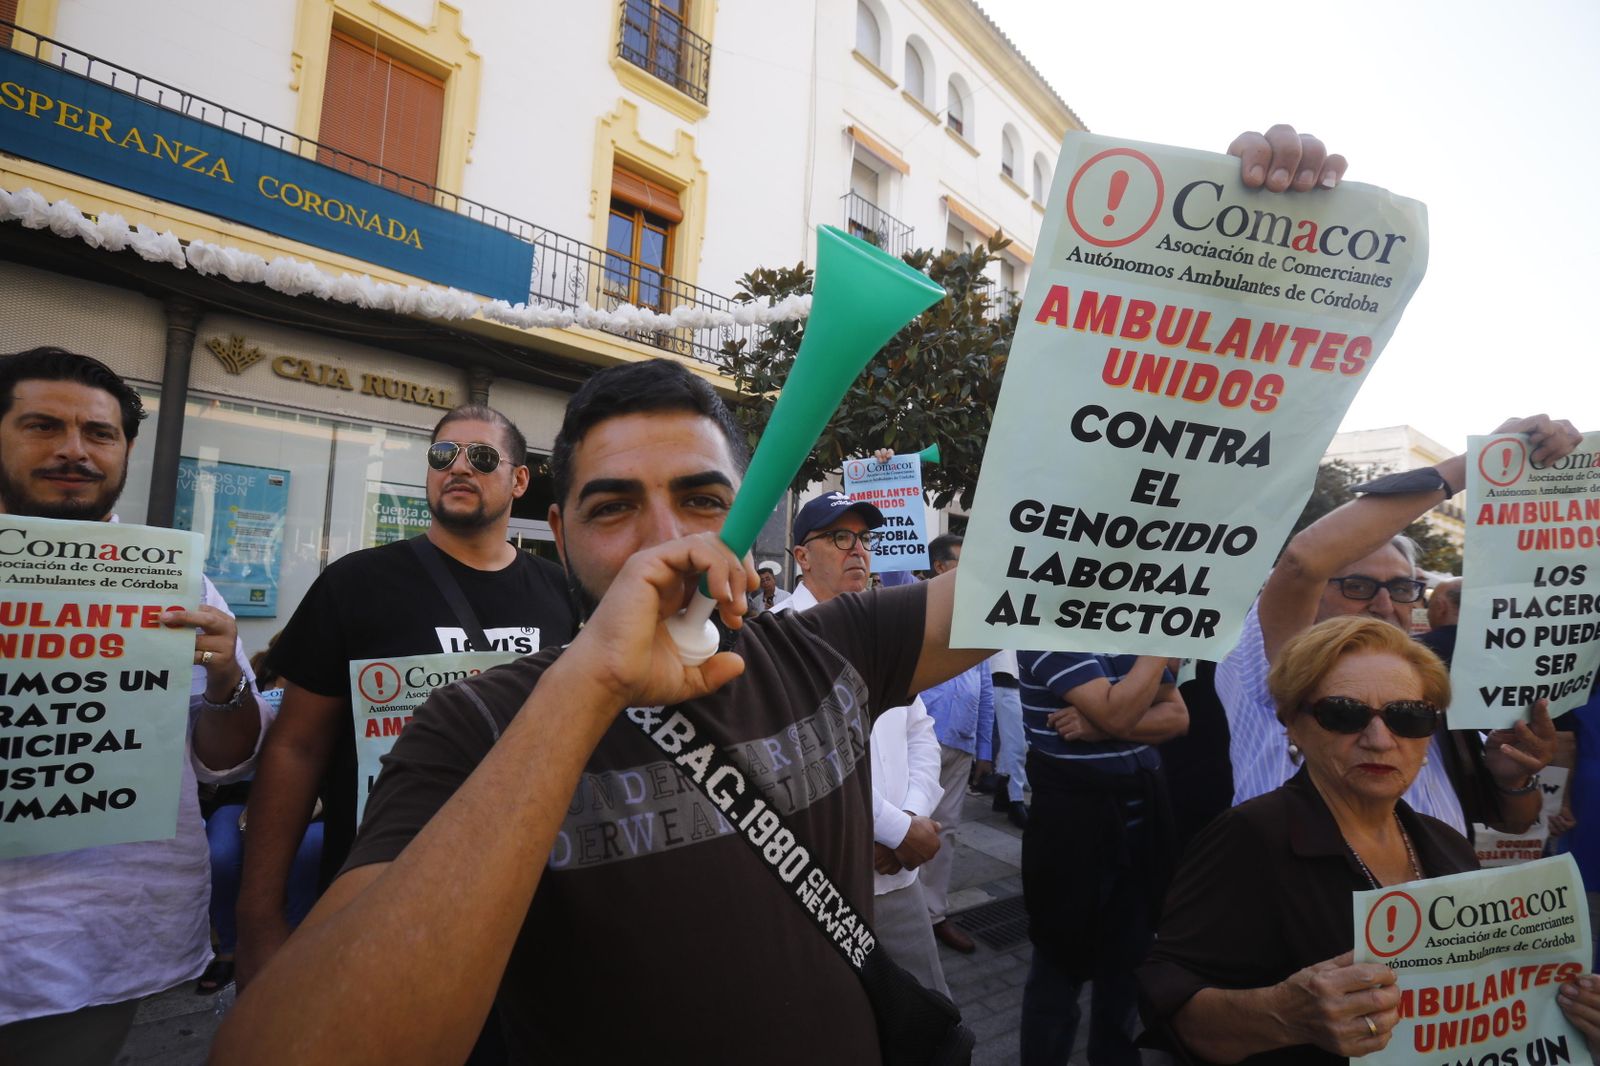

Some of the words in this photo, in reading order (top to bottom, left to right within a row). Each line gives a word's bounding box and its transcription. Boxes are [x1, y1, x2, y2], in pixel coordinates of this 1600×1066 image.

[258, 175, 424, 250] CORONADA
[1172, 180, 1406, 264] Comacor
[1066, 246, 1174, 279] Autónomos
[1180, 266, 1280, 297] Ambulantes
[1285, 283, 1305, 302] de
[1310, 287, 1378, 313] Córdoba
[1155, 233, 1254, 265] Asociación
[1258, 251, 1277, 269] de
[1281, 257, 1392, 288] Comerciantes
[1035, 284, 1373, 375] AMBULANTES
[271, 355, 354, 391] CAJA
[361, 373, 456, 411] RURAL
[1101, 347, 1285, 413] UNIDOS
[1070, 404, 1271, 469] CONTRA
[867, 462, 912, 472] Comacor
[850, 487, 919, 501] AMBULANTES
[1130, 468, 1181, 508] EL
[372, 502, 418, 518] Cuenta
[1009, 499, 1258, 557] GENOCIDIO
[6, 573, 96, 587] Ambulantes
[100, 576, 117, 588] de
[121, 578, 179, 590] Córdoba
[70, 562, 88, 571] de
[92, 563, 182, 577] Comerciantes
[1006, 546, 1211, 597] LABORAL
[1534, 564, 1587, 587] LOS
[984, 589, 1041, 626] AL
[1054, 599, 1221, 639] SECTOR
[1485, 627, 1526, 649] NO
[119, 670, 169, 693] UN
[1534, 653, 1577, 677] SER
[1479, 670, 1593, 708] VERDUGOS
[0, 788, 137, 823] MANO
[1428, 885, 1567, 931] Comacor
[1425, 931, 1490, 949] Asociación
[1492, 928, 1507, 940] de
[1510, 914, 1575, 937] Comerciantes
[1446, 943, 1510, 965] Ambulantes
[1512, 939, 1529, 952] de
[1531, 932, 1576, 950] Córdoba
[1413, 999, 1527, 1053] UNIDOS
[1526, 1034, 1571, 1066] UN
